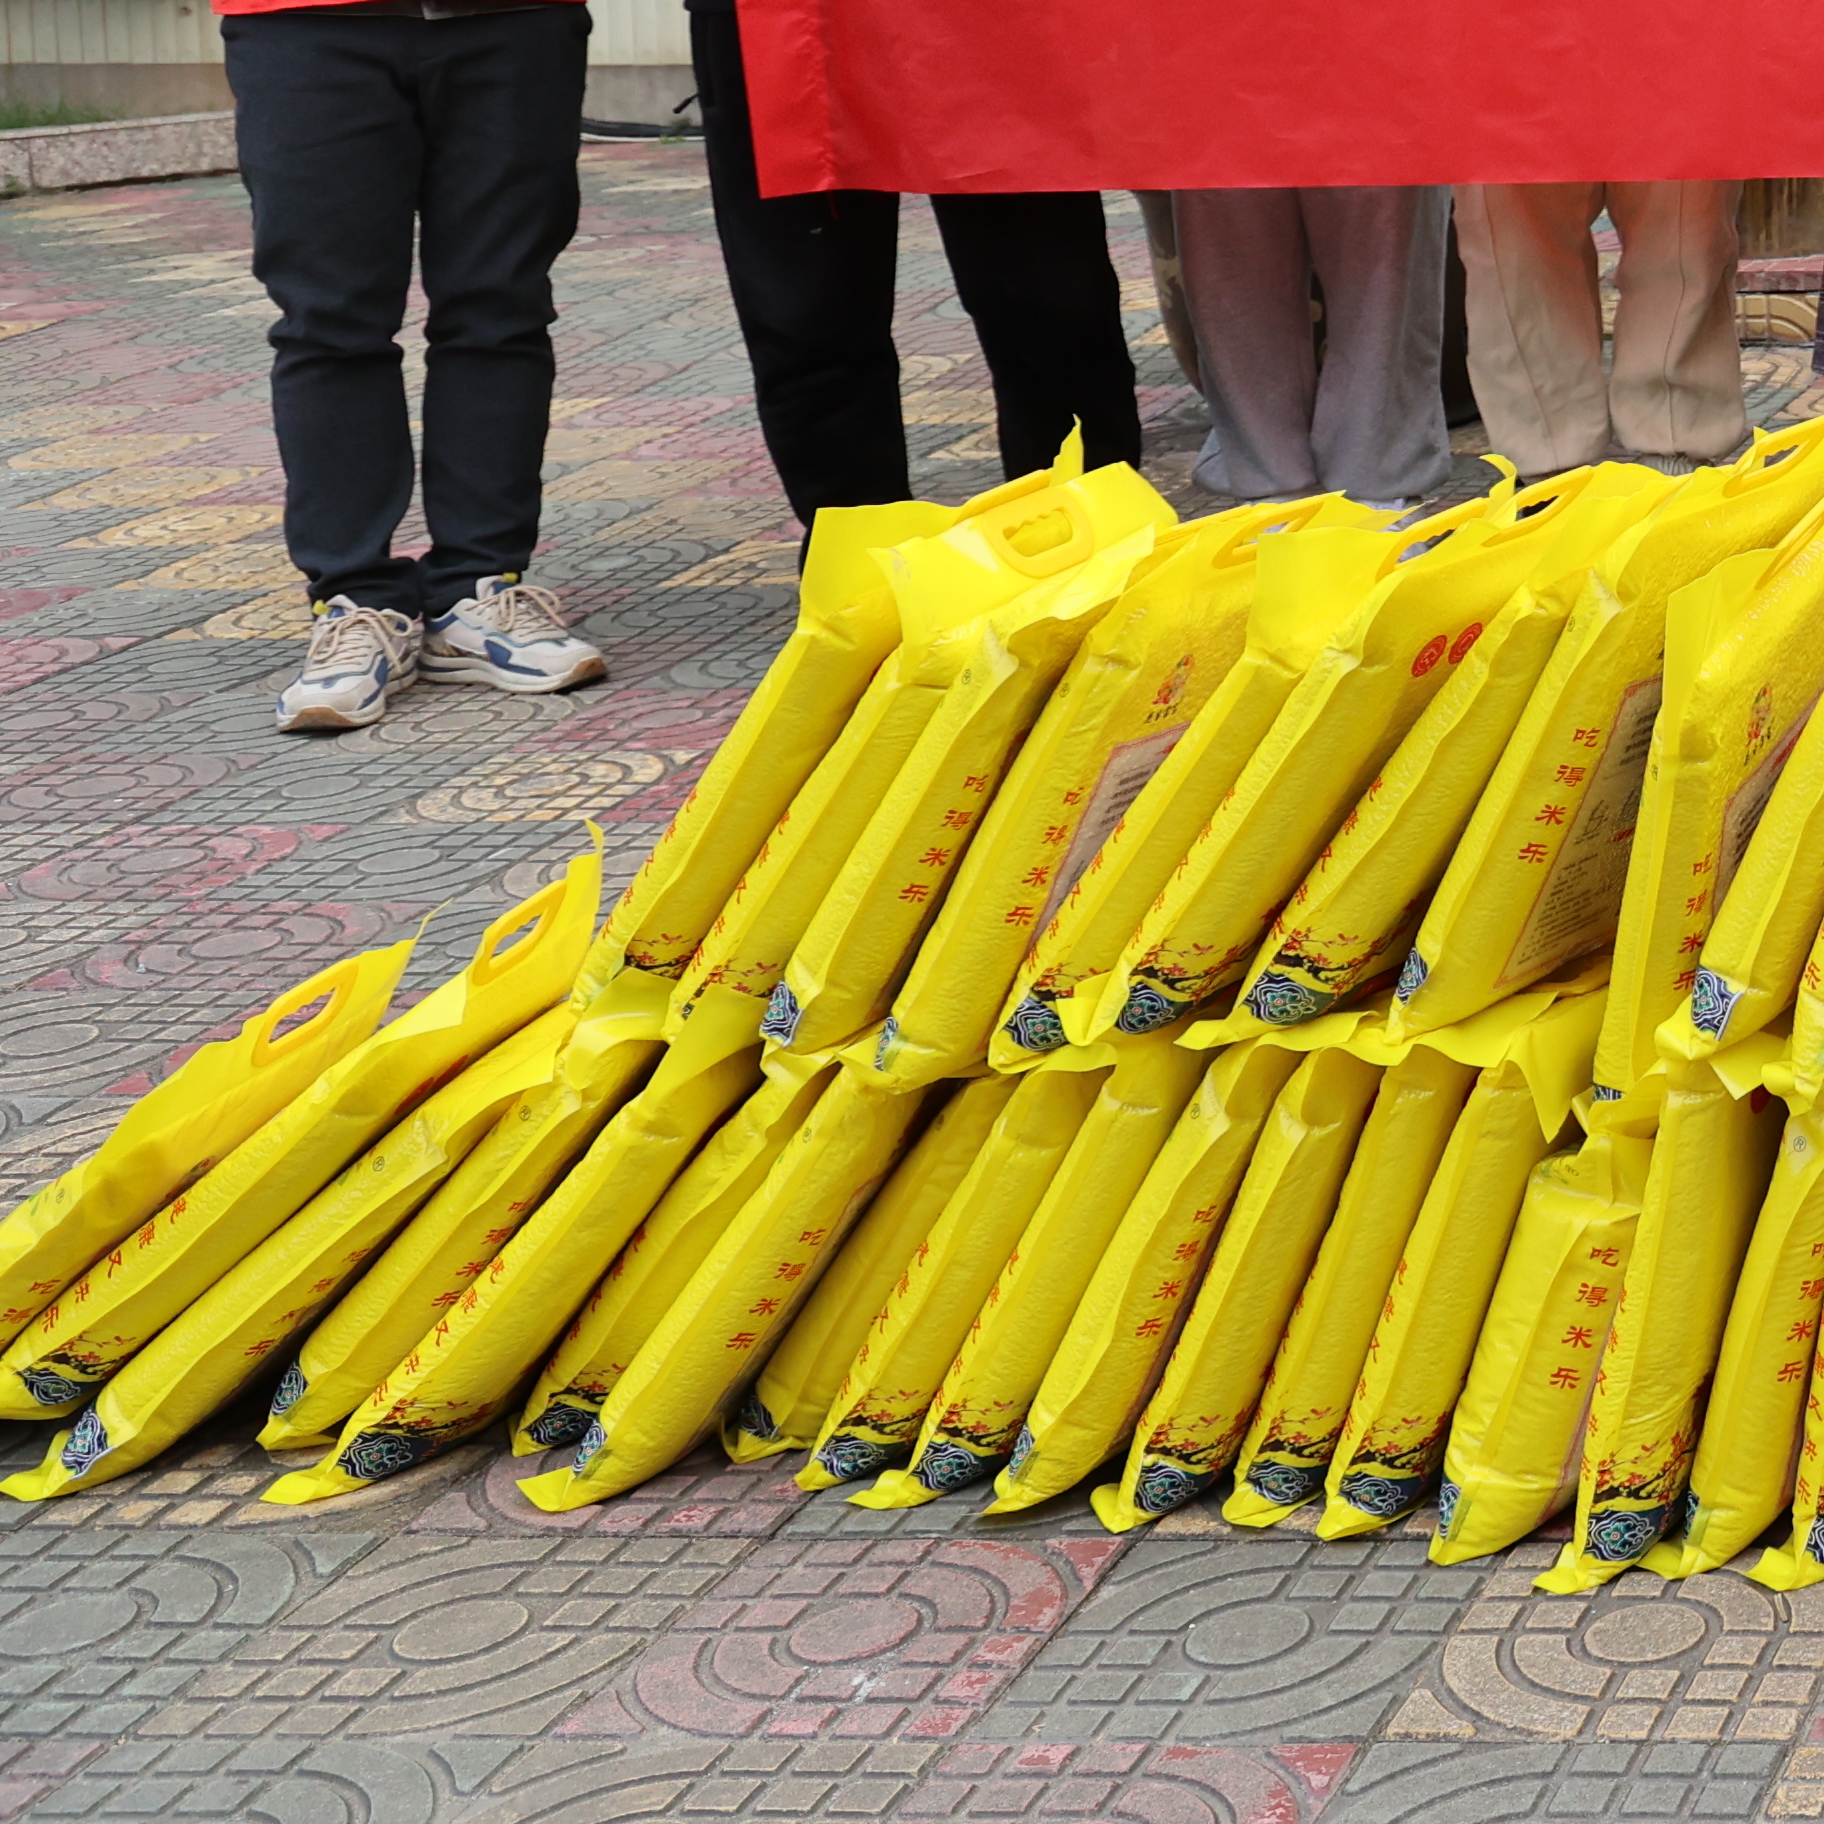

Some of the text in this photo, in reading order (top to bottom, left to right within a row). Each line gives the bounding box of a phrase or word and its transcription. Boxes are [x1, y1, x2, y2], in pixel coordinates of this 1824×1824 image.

[899, 774, 989, 905] 吃得米乐
[1004, 787, 1084, 927] 吃得米乐
[1518, 726, 1601, 867] 吃得米乐
[726, 1228, 823, 1352] 吃得米乐
[1135, 1205, 1217, 1338] 吃得米乐
[1549, 1246, 1620, 1389] 吃得米乐
